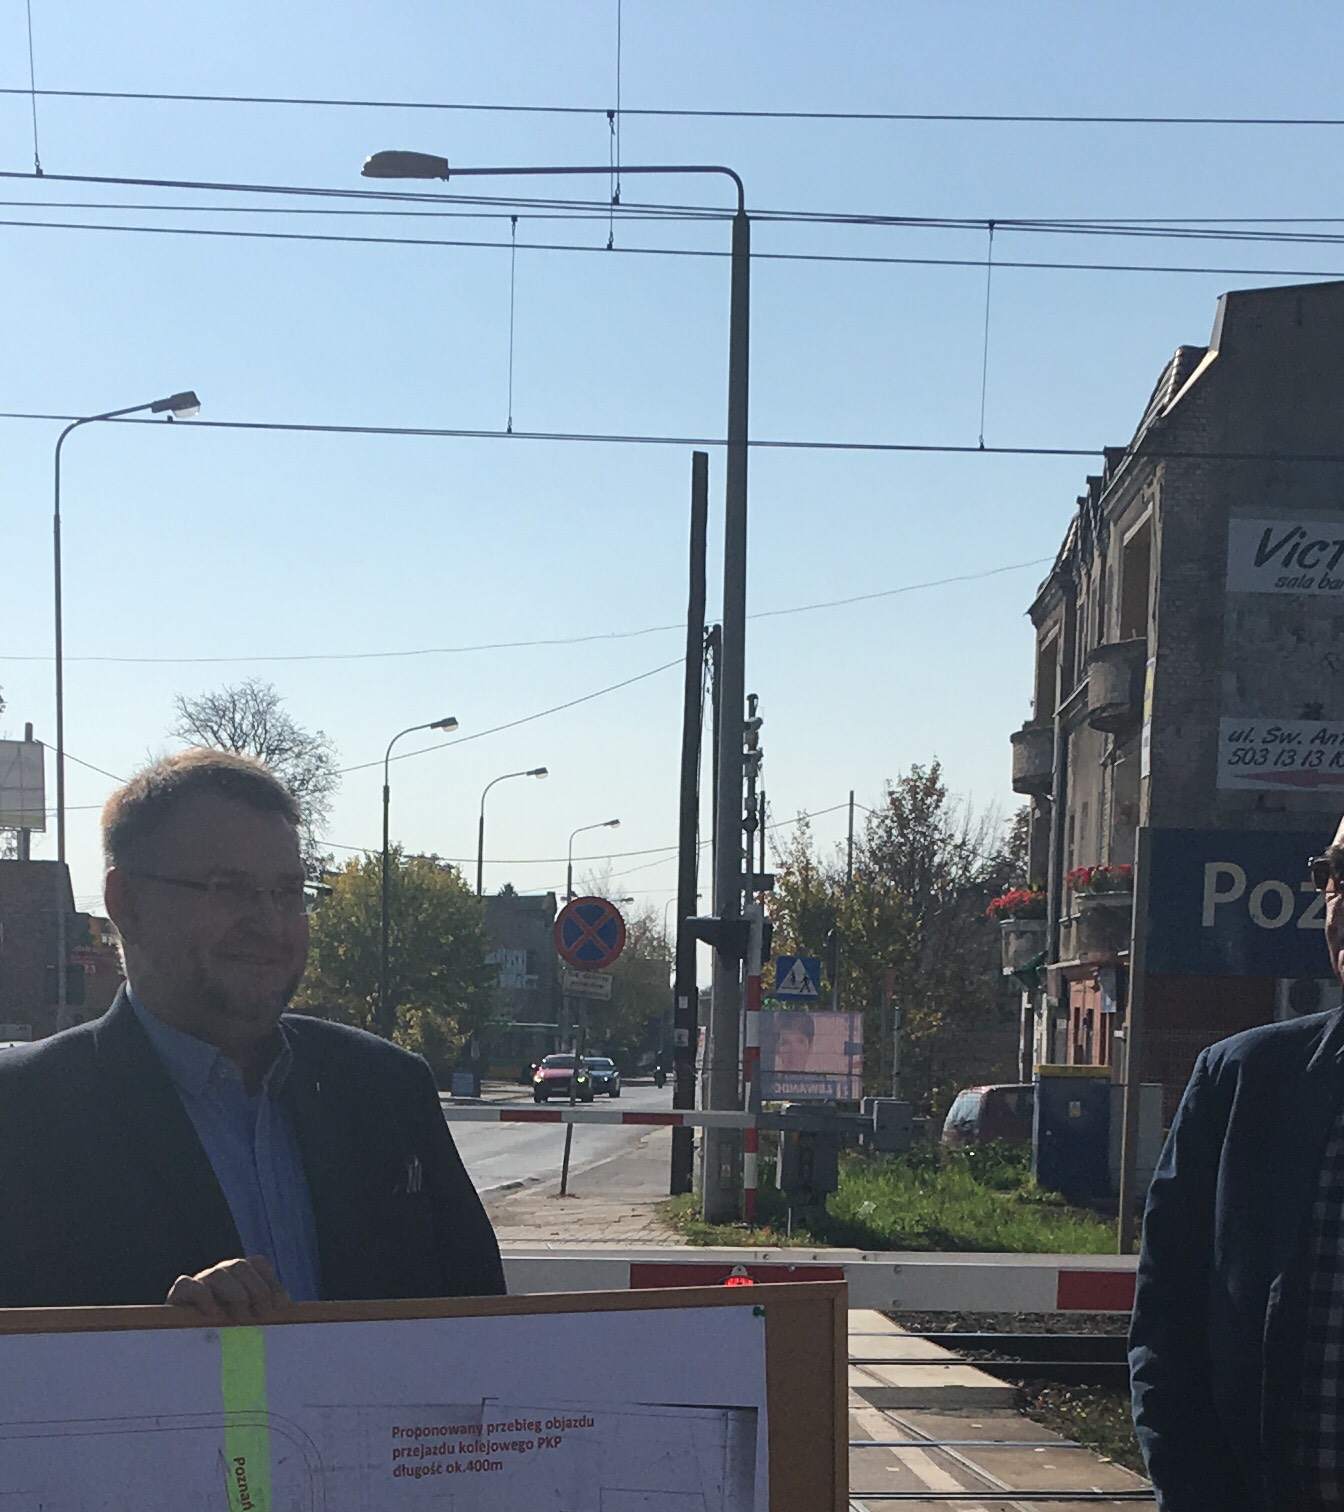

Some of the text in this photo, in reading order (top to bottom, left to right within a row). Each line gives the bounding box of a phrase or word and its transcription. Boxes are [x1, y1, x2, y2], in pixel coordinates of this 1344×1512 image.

[1274, 573, 1315, 590] sala
[1227, 727, 1255, 744] ul.
[1227, 747, 1269, 766] 503
[1273, 749, 1297, 767] 13
[1300, 749, 1325, 768] 13
[392, 1415, 595, 1440] Proponowany przebieg objazdu
[392, 1436, 562, 1461] przejazdu kolejowego PKP
[393, 1462, 443, 1479] długość
[232, 1456, 256, 1511] Poznań
